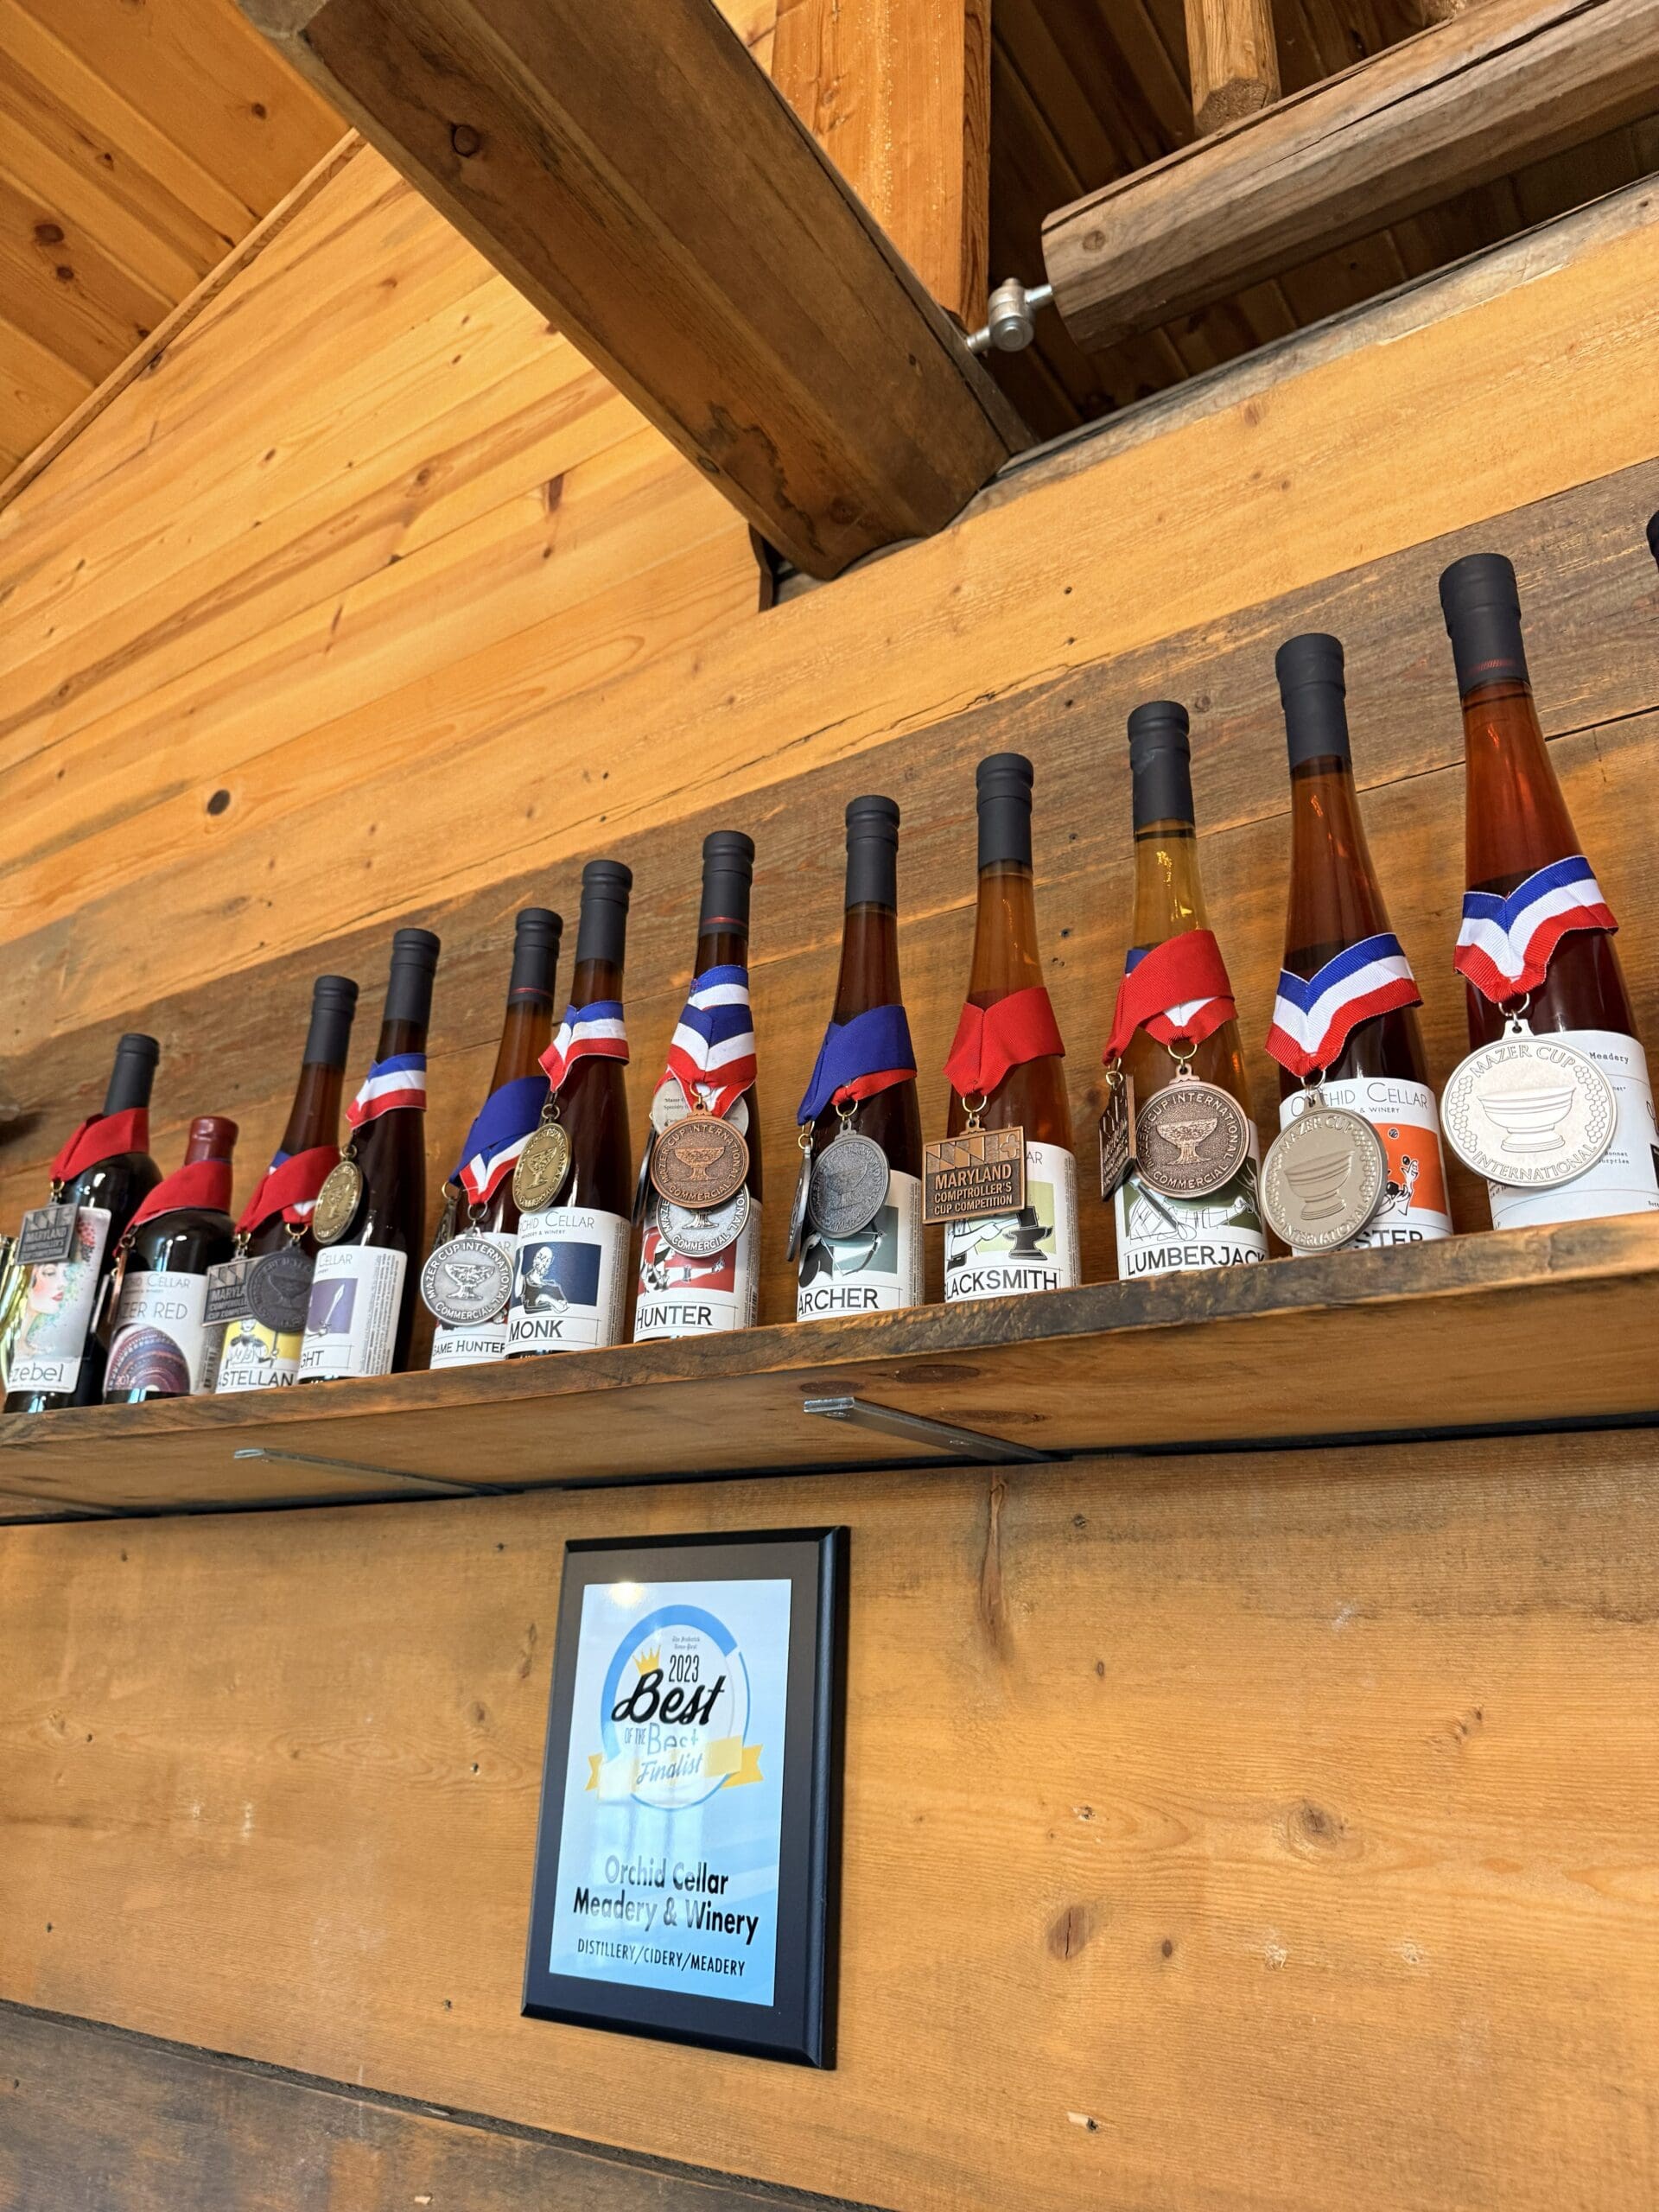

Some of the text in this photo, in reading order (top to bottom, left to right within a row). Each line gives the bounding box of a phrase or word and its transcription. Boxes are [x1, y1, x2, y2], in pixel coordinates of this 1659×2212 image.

[1470, 1045, 1575, 1077] MAZER CUP
[1589, 1052, 1629, 1064] Meadery
[1291, 1082, 1427, 1117] OHID CELLAR
[1148, 1101, 1168, 1122] CUP
[1173, 1091, 1238, 1164] INTERNATIONAL
[1280, 1116, 1355, 1154] MAZER CUP
[659, 1124, 741, 1184] MAZER CUP INTERNATIONAL
[1472, 1143, 1598, 1181] INTERNATIONAL
[669, 1183, 732, 1201] COMMERCIAL
[935, 1164, 1012, 1191] MARYLAND
[1154, 1165, 1229, 1190] COMMERCIAL
[934, 1181, 1012, 1204] COMPTROLLER'S
[934, 1194, 1013, 1216] CUP COMPETITION
[545, 1211, 594, 1229] CELLAR
[660, 1198, 672, 1233] MAZE
[1283, 1204, 1369, 1246] INTERNATIONAL
[672, 1233, 732, 1251] COMMERCIAL
[148, 1274, 191, 1288] CELLAR
[424, 1242, 510, 1304] MAZER CUP INTERNATIONAL
[946, 1269, 1057, 1300] LACKSMITH
[211, 1285, 247, 1302] MARYLA
[798, 1287, 879, 1319] ARCHER
[154, 1302, 188, 1320] RED
[435, 1301, 493, 1320] COMMERCIAL
[636, 1306, 713, 1331] HUNTER
[509, 1319, 563, 1342] MONK
[219, 1370, 294, 1387] STELLAN
[669, 1655, 700, 1683] 2023
[611, 1669, 725, 1726] Best
[636, 1752, 704, 1785] Finalist
[605, 1855, 728, 1895] Orchid Cellar
[573, 1886, 759, 1945] Meadery & Winery
[578, 1938, 745, 1977] DISTILLERY/CIDERY/MEADERY
